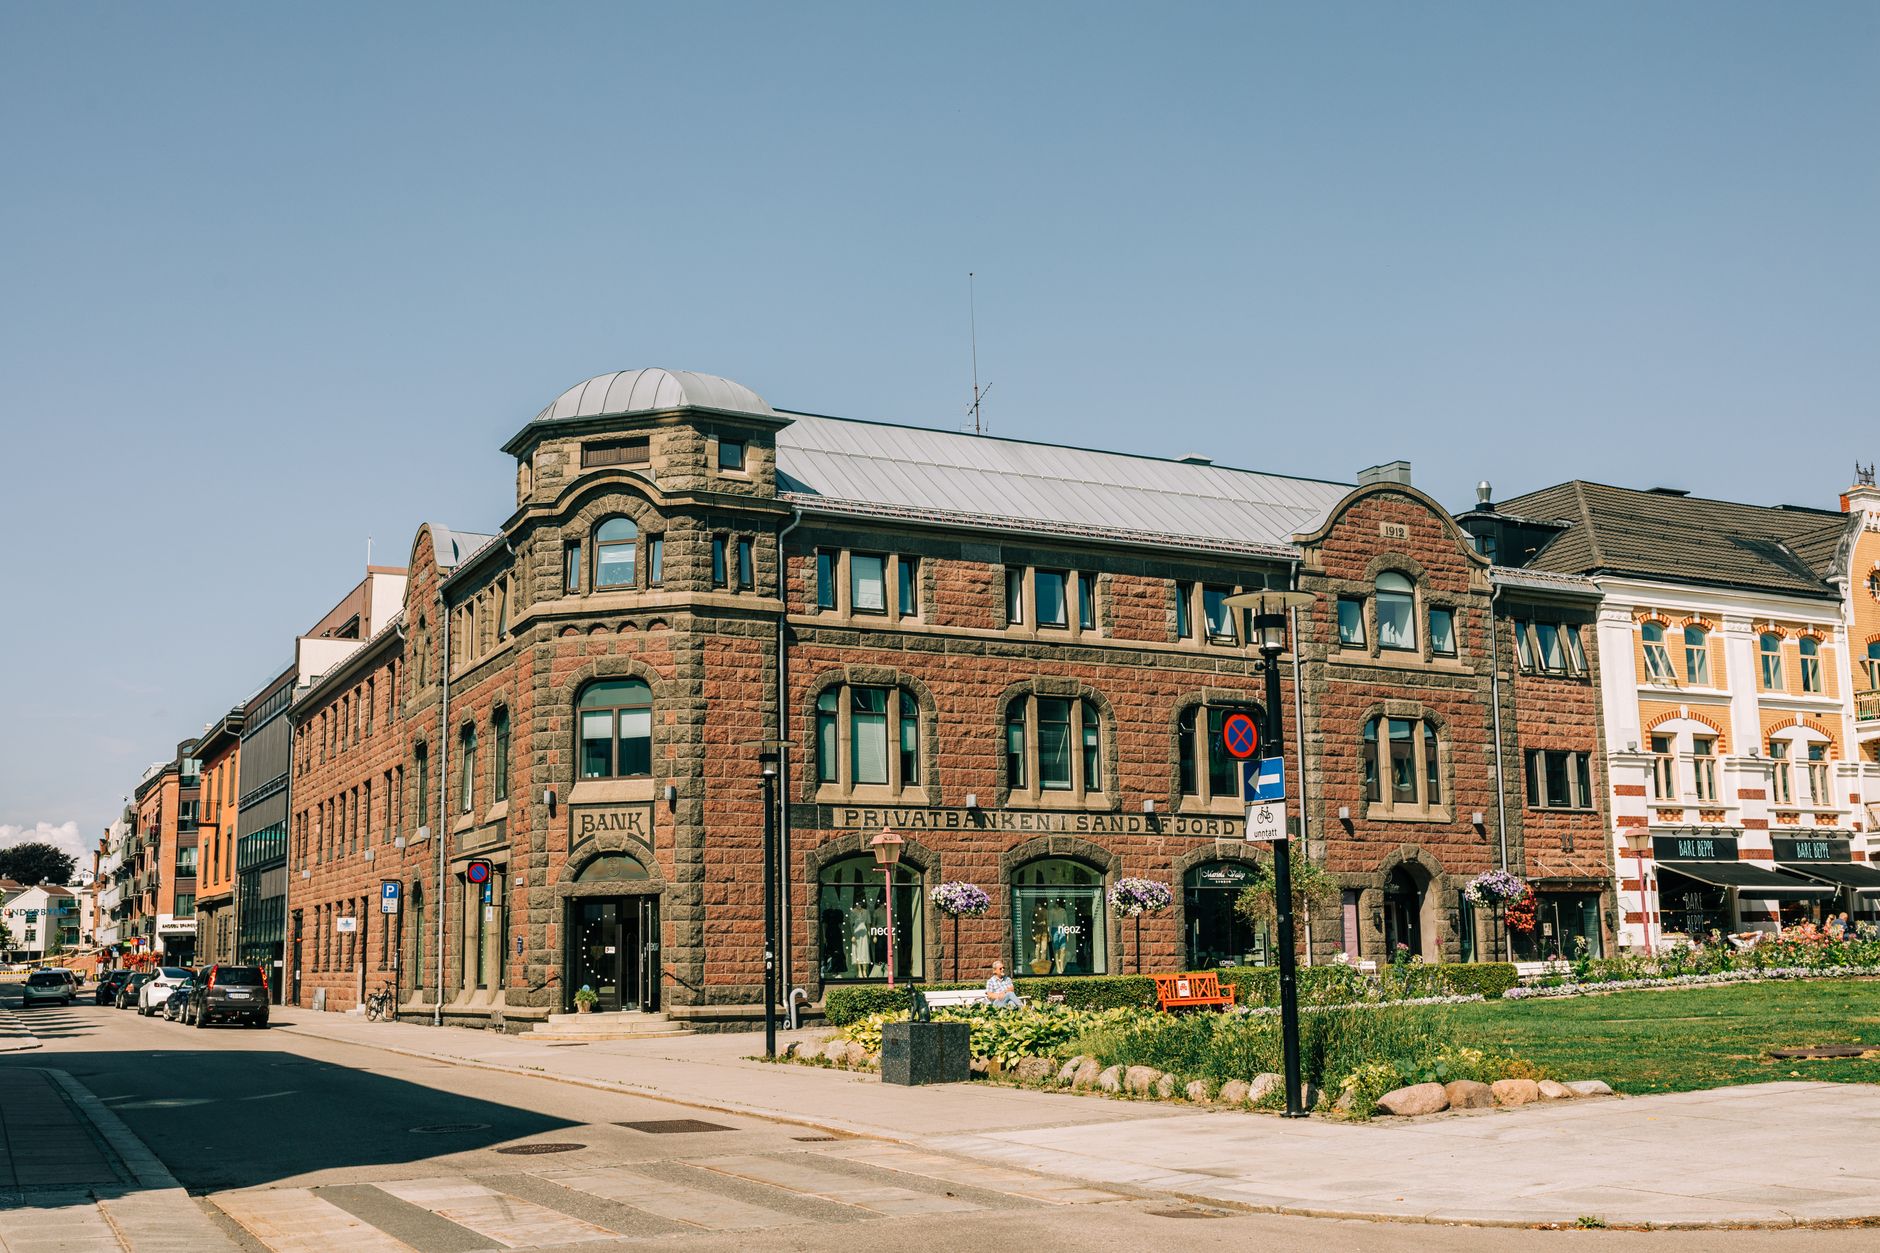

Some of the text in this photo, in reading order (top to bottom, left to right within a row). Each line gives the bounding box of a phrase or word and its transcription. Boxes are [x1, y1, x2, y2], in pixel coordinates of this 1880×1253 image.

[1385, 526, 1405, 537] 1912
[577, 812, 646, 838] BANK
[844, 809, 1235, 835] PRIVATBANKEN I SANDEFJORD
[1253, 829, 1278, 838] unntatt
[1678, 840, 1715, 858] BARE BEPPE
[1796, 842, 1831, 859] BARE BEPPE
[386, 885, 395, 897] P
[870, 926, 896, 936] neoz
[1057, 925, 1081, 934] neoz
